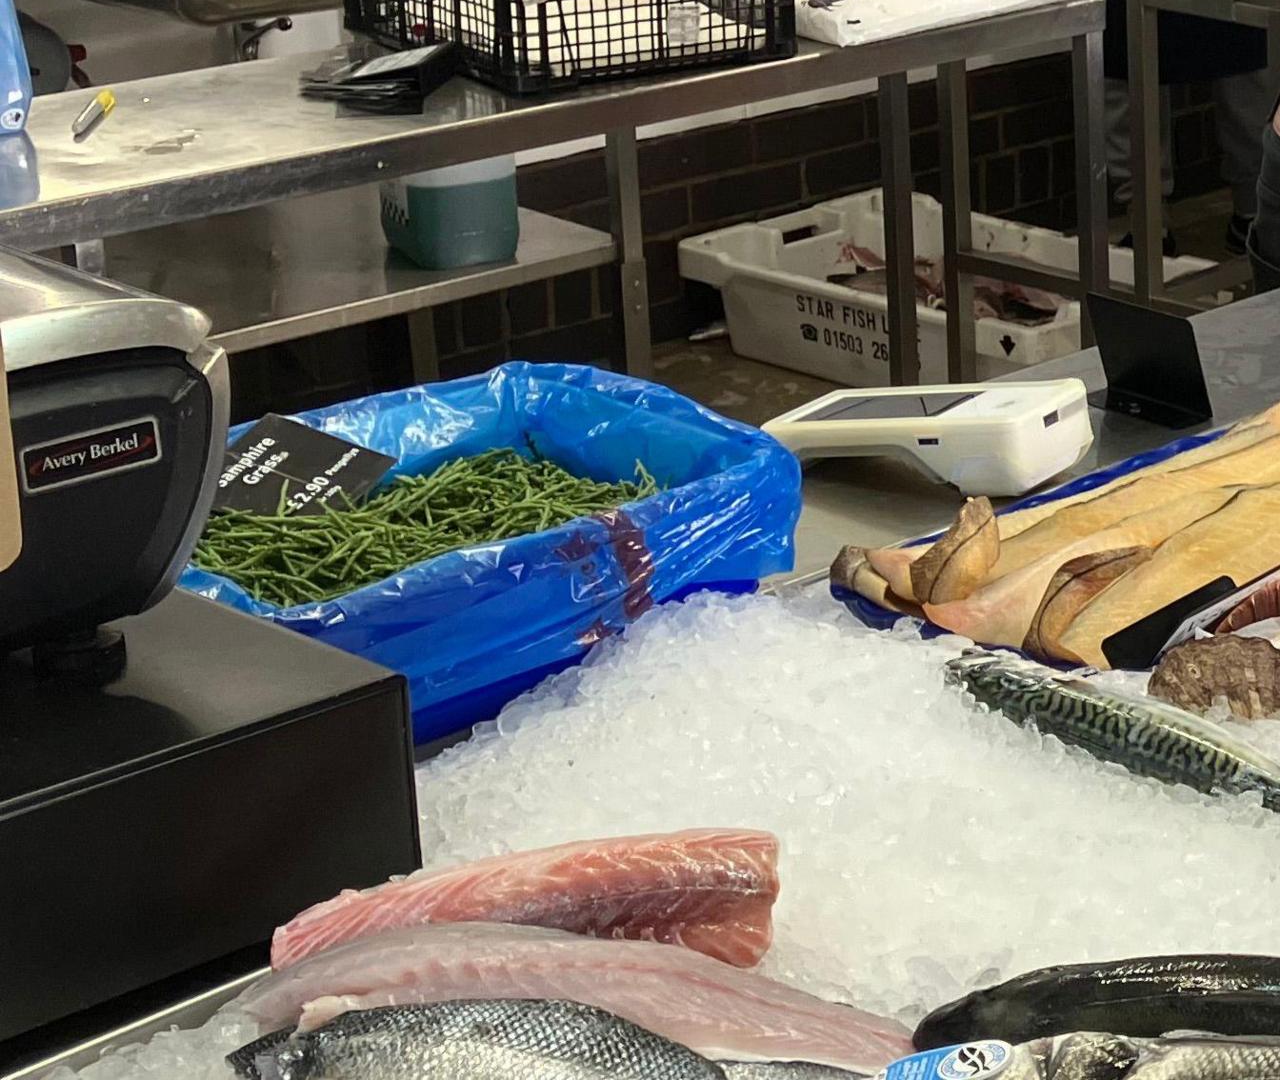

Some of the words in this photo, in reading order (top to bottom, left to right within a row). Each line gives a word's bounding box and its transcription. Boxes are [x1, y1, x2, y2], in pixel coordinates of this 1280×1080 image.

[796, 295, 834, 320] STAR
[842, 306, 877, 331] FISH
[823, 328, 863, 355] 01503
[42, 450, 86, 472] Avery
[90, 432, 138, 460] Berkel
